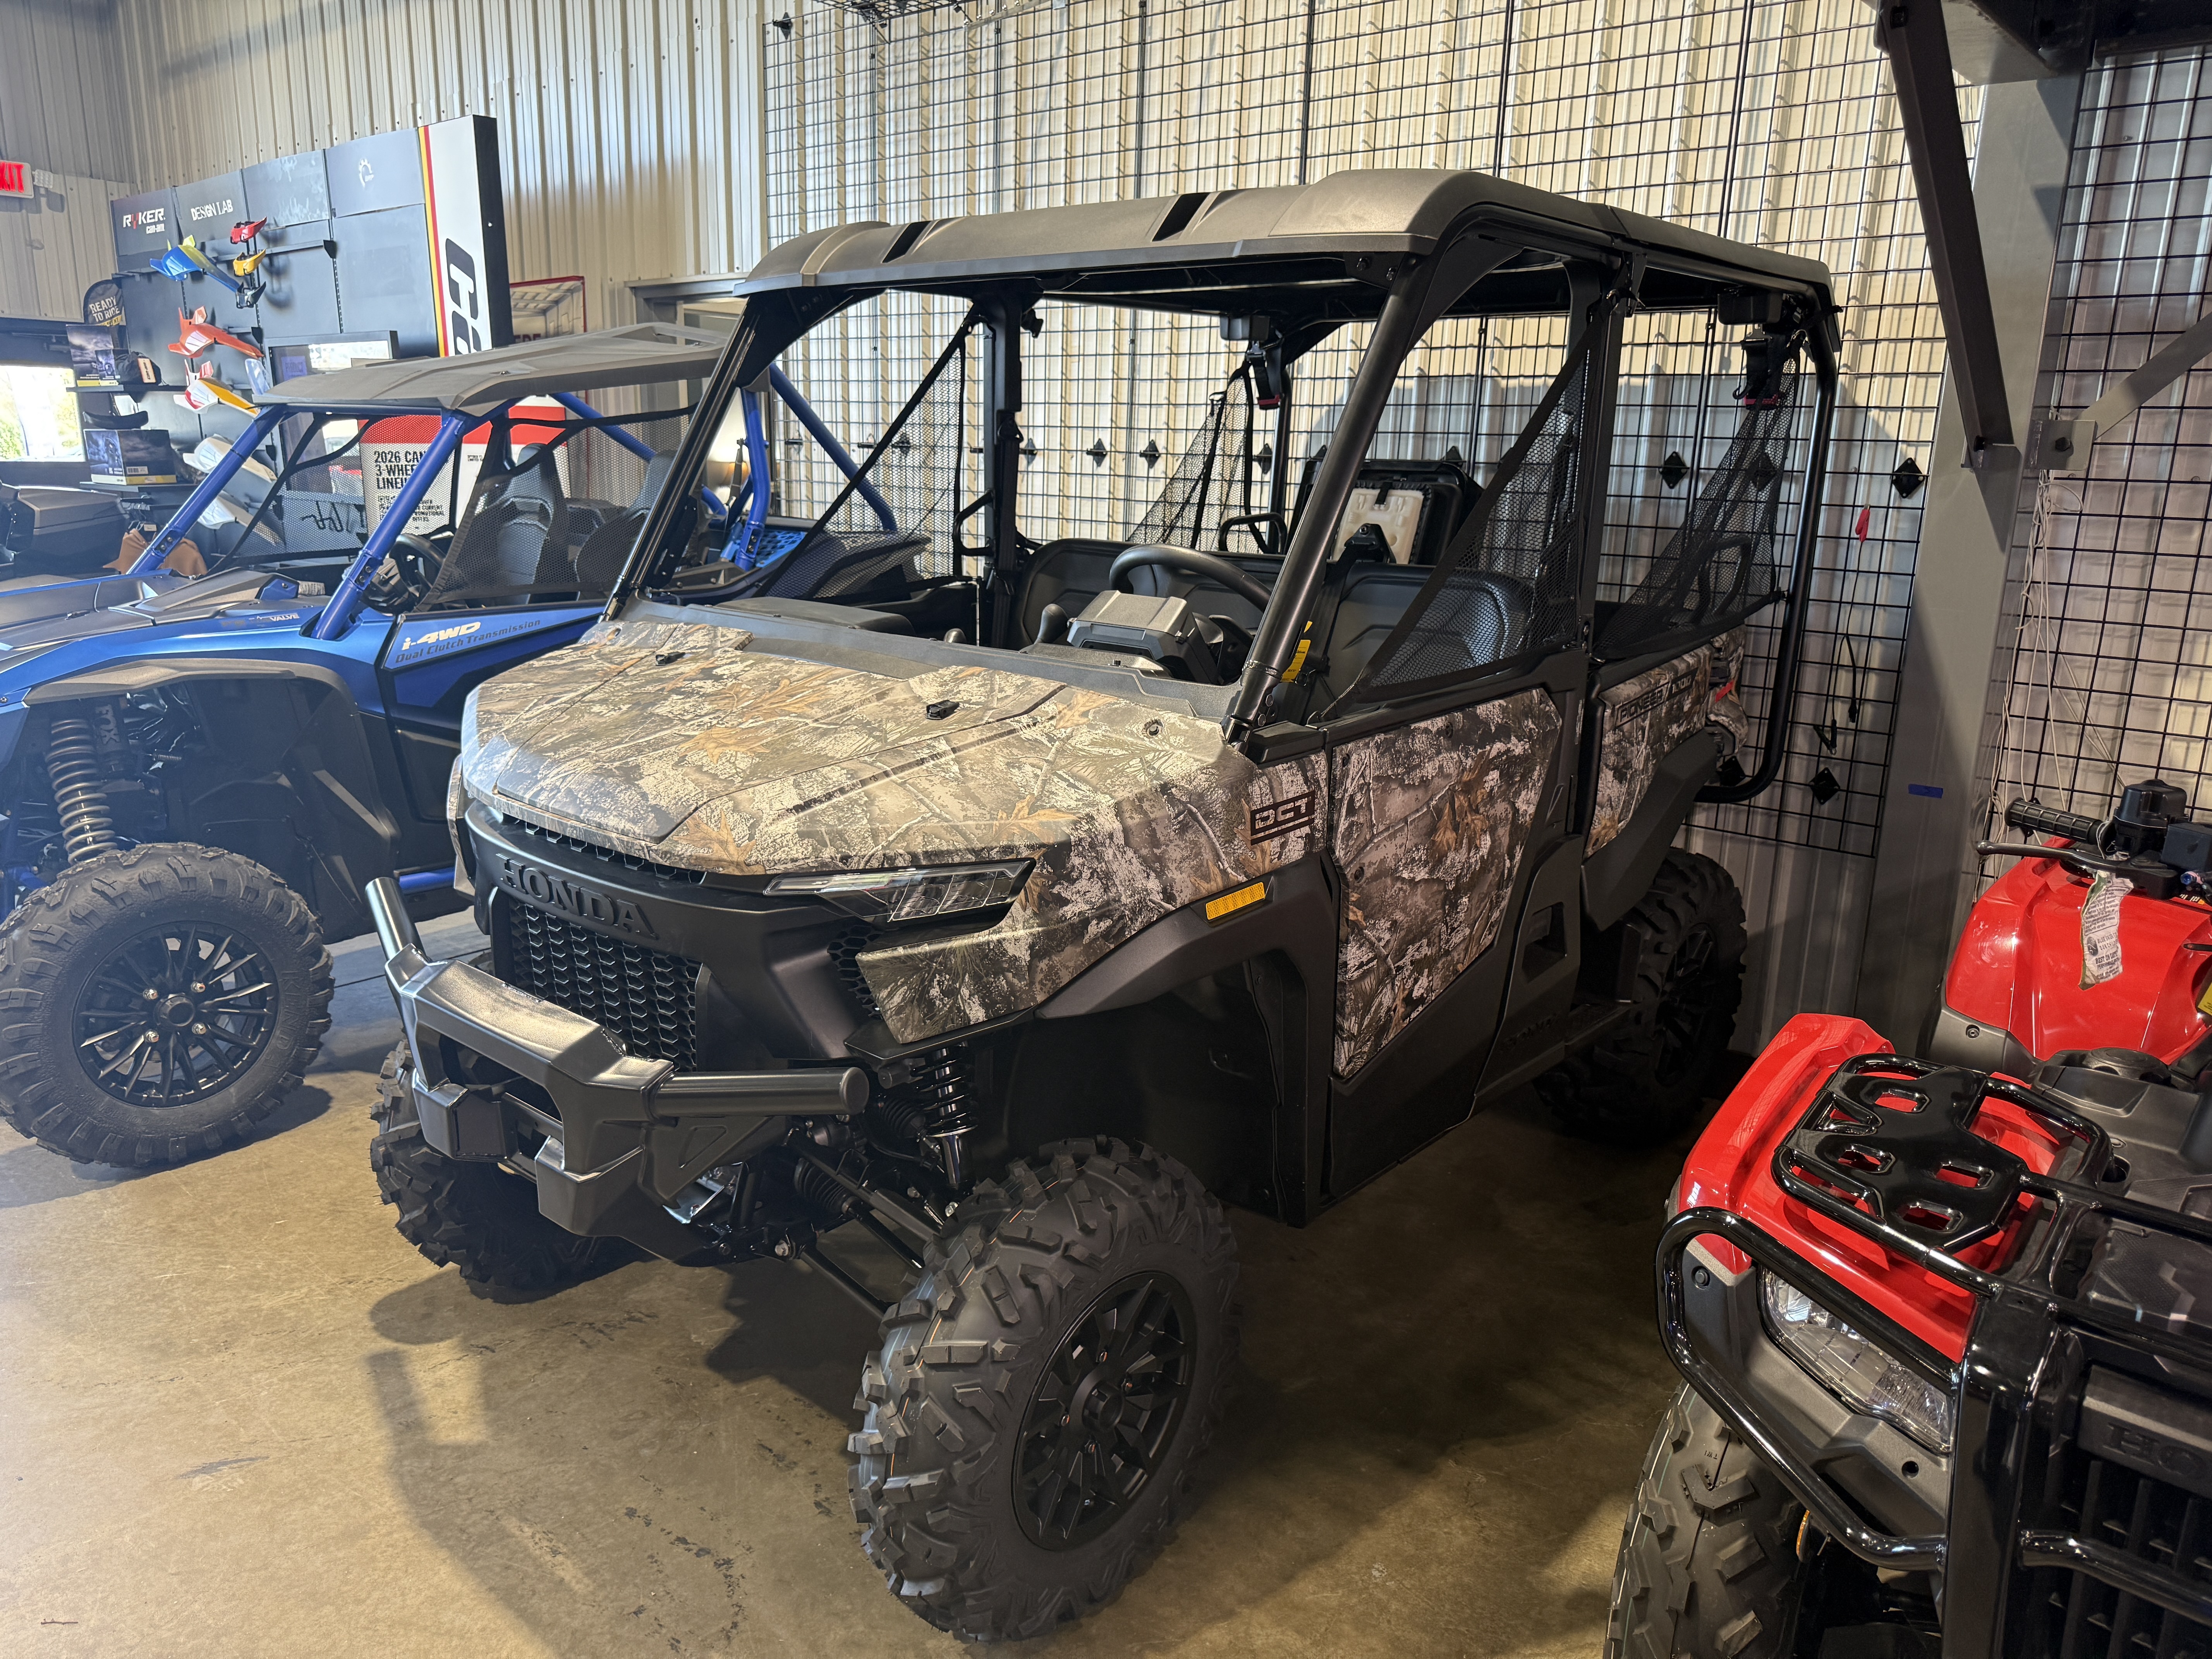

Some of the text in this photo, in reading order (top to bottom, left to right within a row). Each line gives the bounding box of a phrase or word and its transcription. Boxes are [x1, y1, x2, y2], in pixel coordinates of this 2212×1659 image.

[191, 199, 233, 220] DESIGN LAB
[89, 296, 116, 314] READY
[93, 306, 120, 322] TO RIDE
[374, 451, 400, 463] 2026
[395, 620, 541, 663] Dual Clutch Transmission
[402, 622, 481, 650] i-4WD
[1672, 675, 1692, 694] 1000
[1255, 797, 1311, 830] DCT
[496, 853, 659, 940] HONDA
[2095, 956, 2105, 964] BEST
